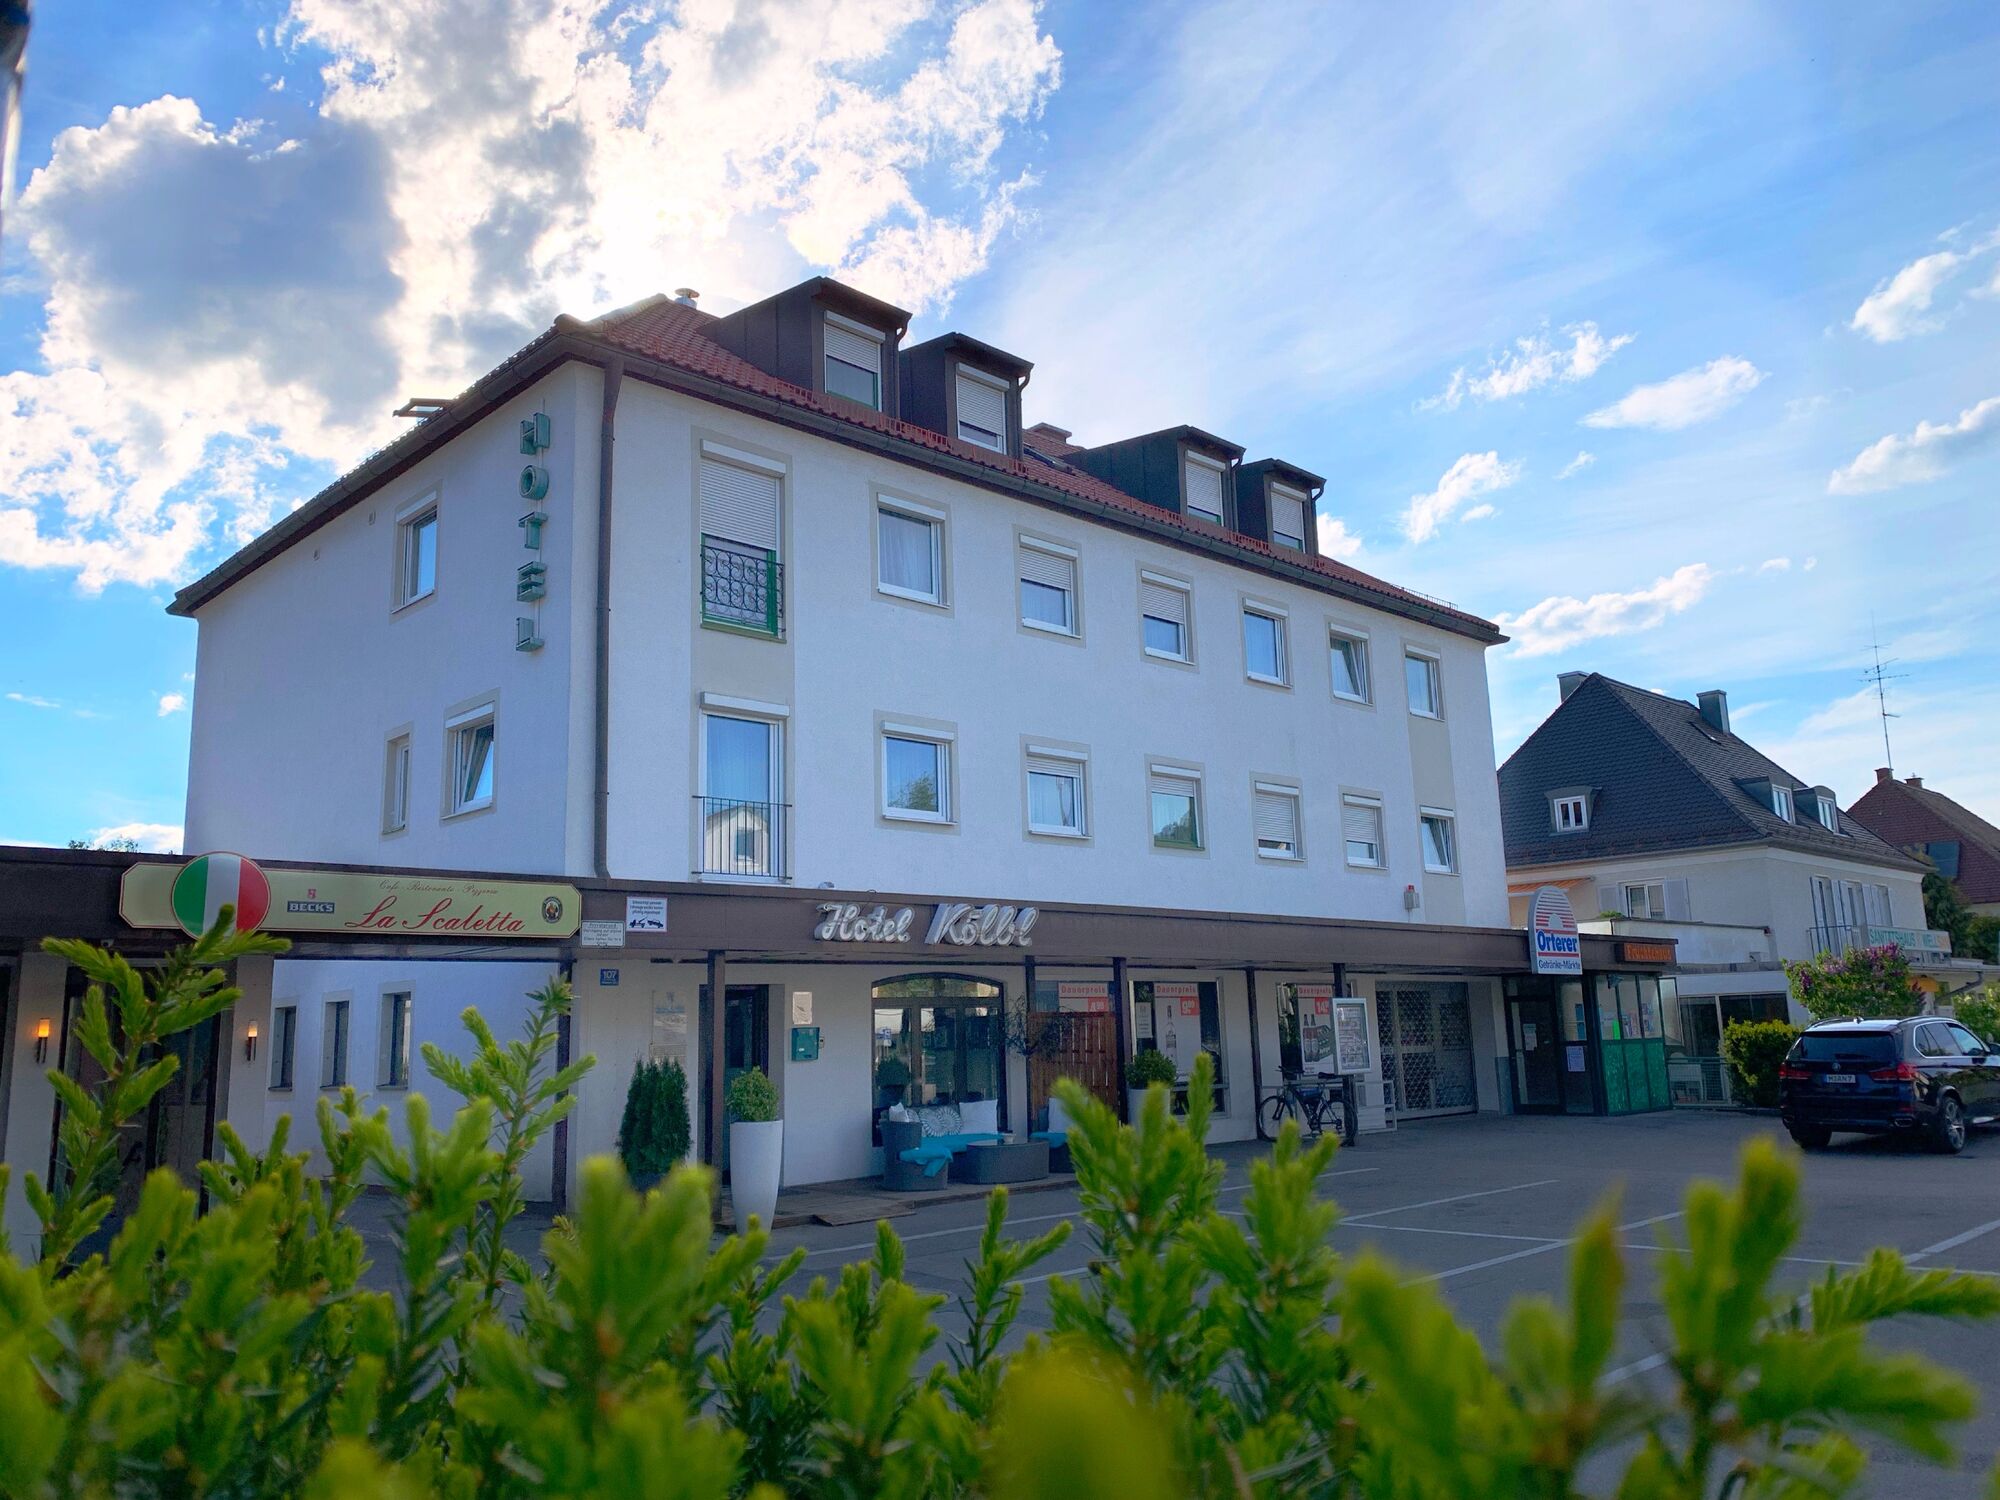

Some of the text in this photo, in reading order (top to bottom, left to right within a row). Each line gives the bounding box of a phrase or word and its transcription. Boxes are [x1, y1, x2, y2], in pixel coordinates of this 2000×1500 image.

[516, 412, 550, 651] HOTEL
[288, 902, 334, 912] BECK'S
[344, 895, 398, 929] La
[402, 898, 526, 932] Scaletta
[814, 902, 1039, 946] Hotel Kölbl
[1537, 929, 1577, 952] Orterer
[602, 970, 617, 979] 107
